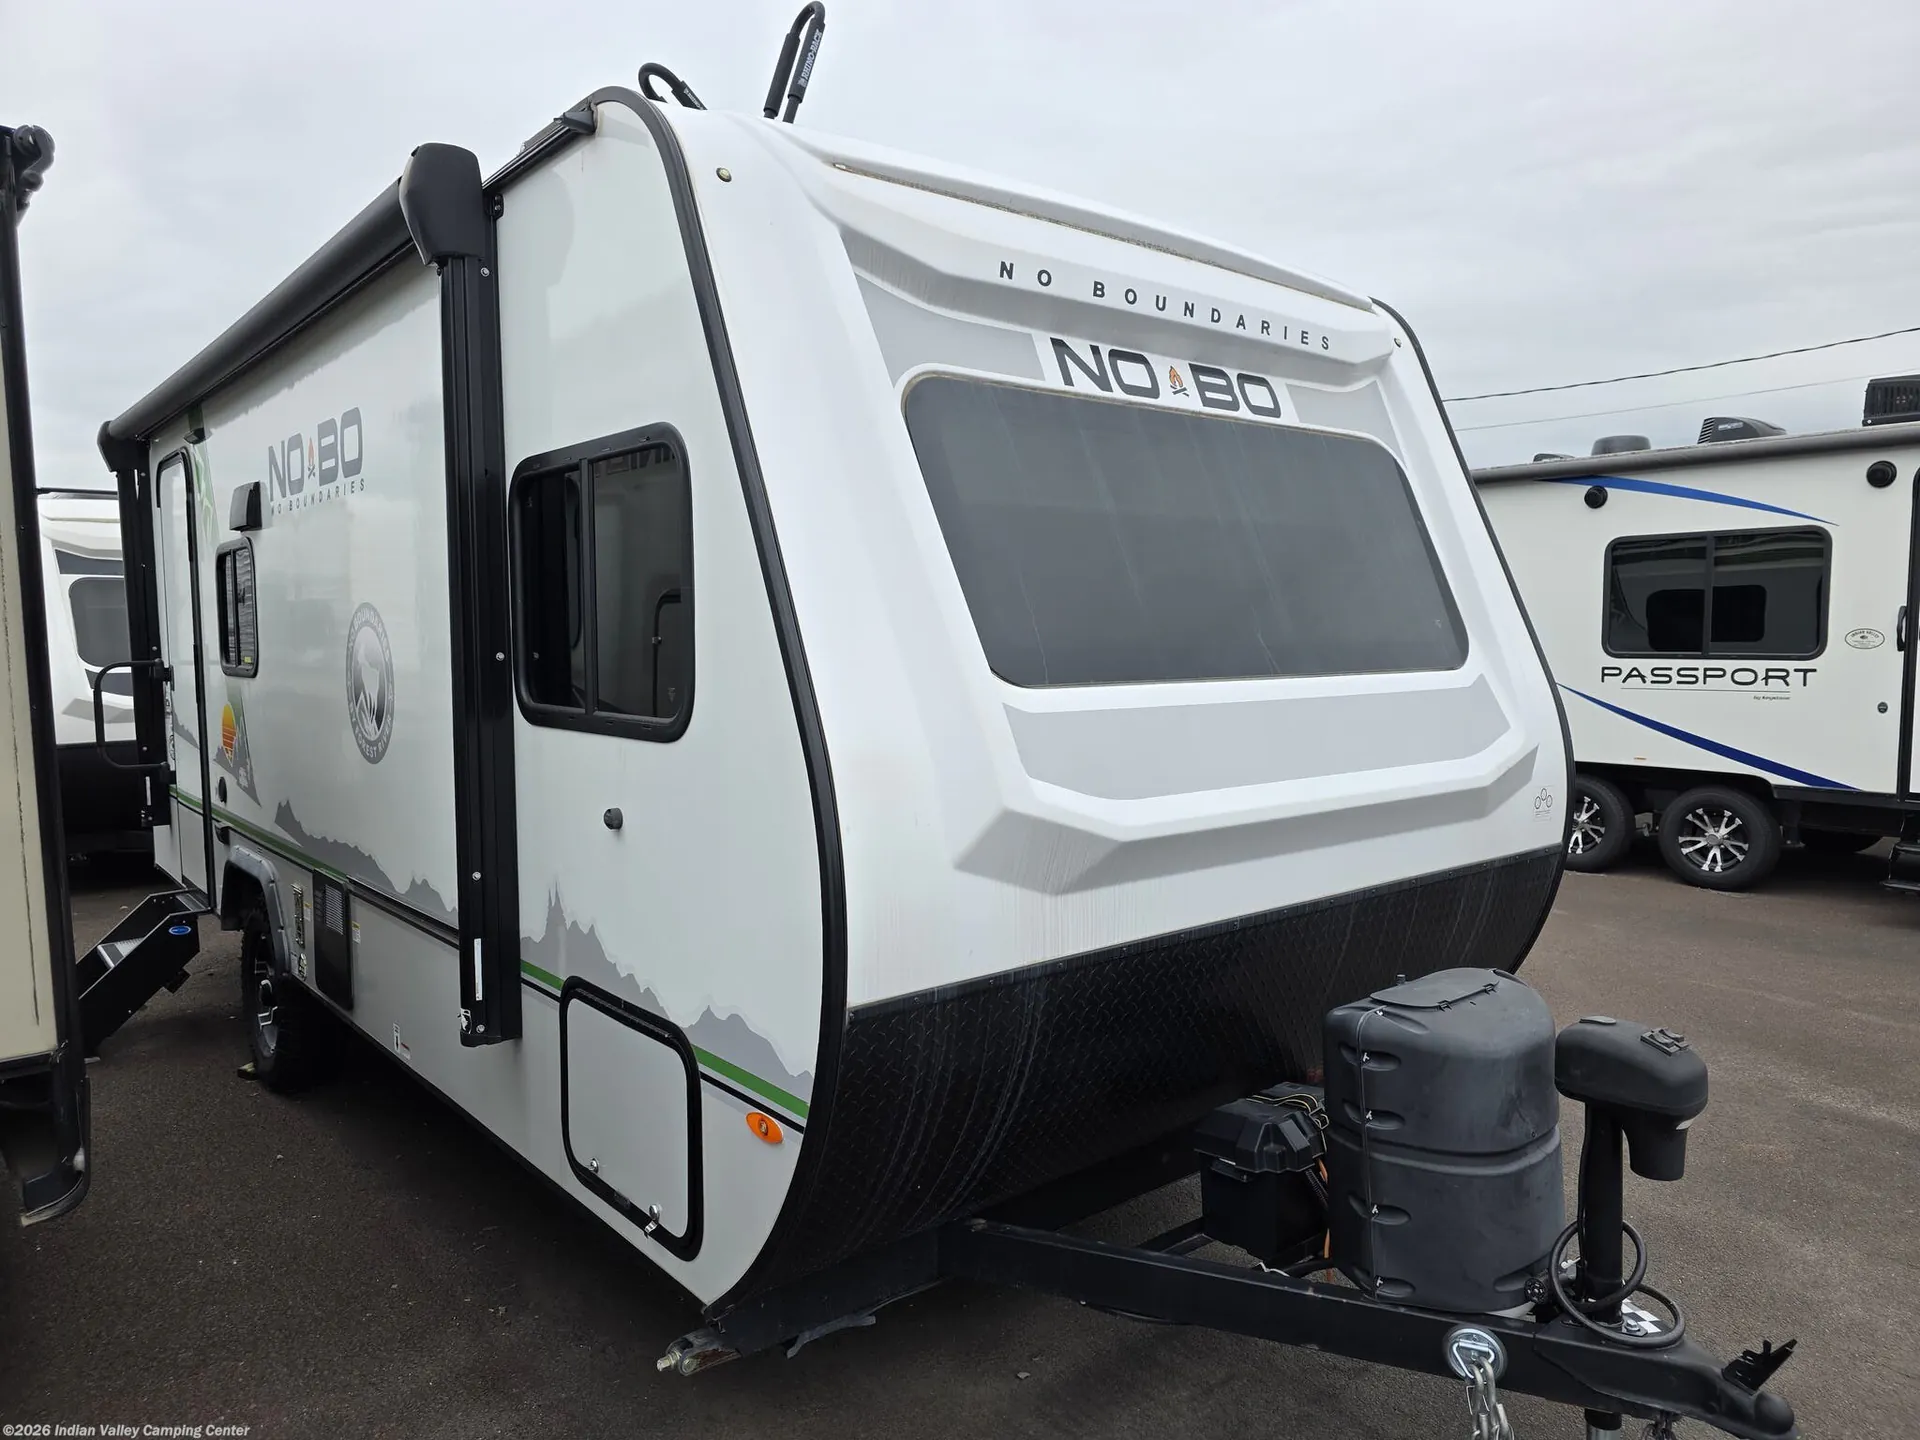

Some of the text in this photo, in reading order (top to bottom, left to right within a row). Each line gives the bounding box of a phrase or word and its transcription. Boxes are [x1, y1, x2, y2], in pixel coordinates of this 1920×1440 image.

[999, 261, 1329, 350] NO BOUNDARIES
[289, 478, 365, 511] BOUNDARIES
[1601, 666, 1817, 687] PASSPORT
